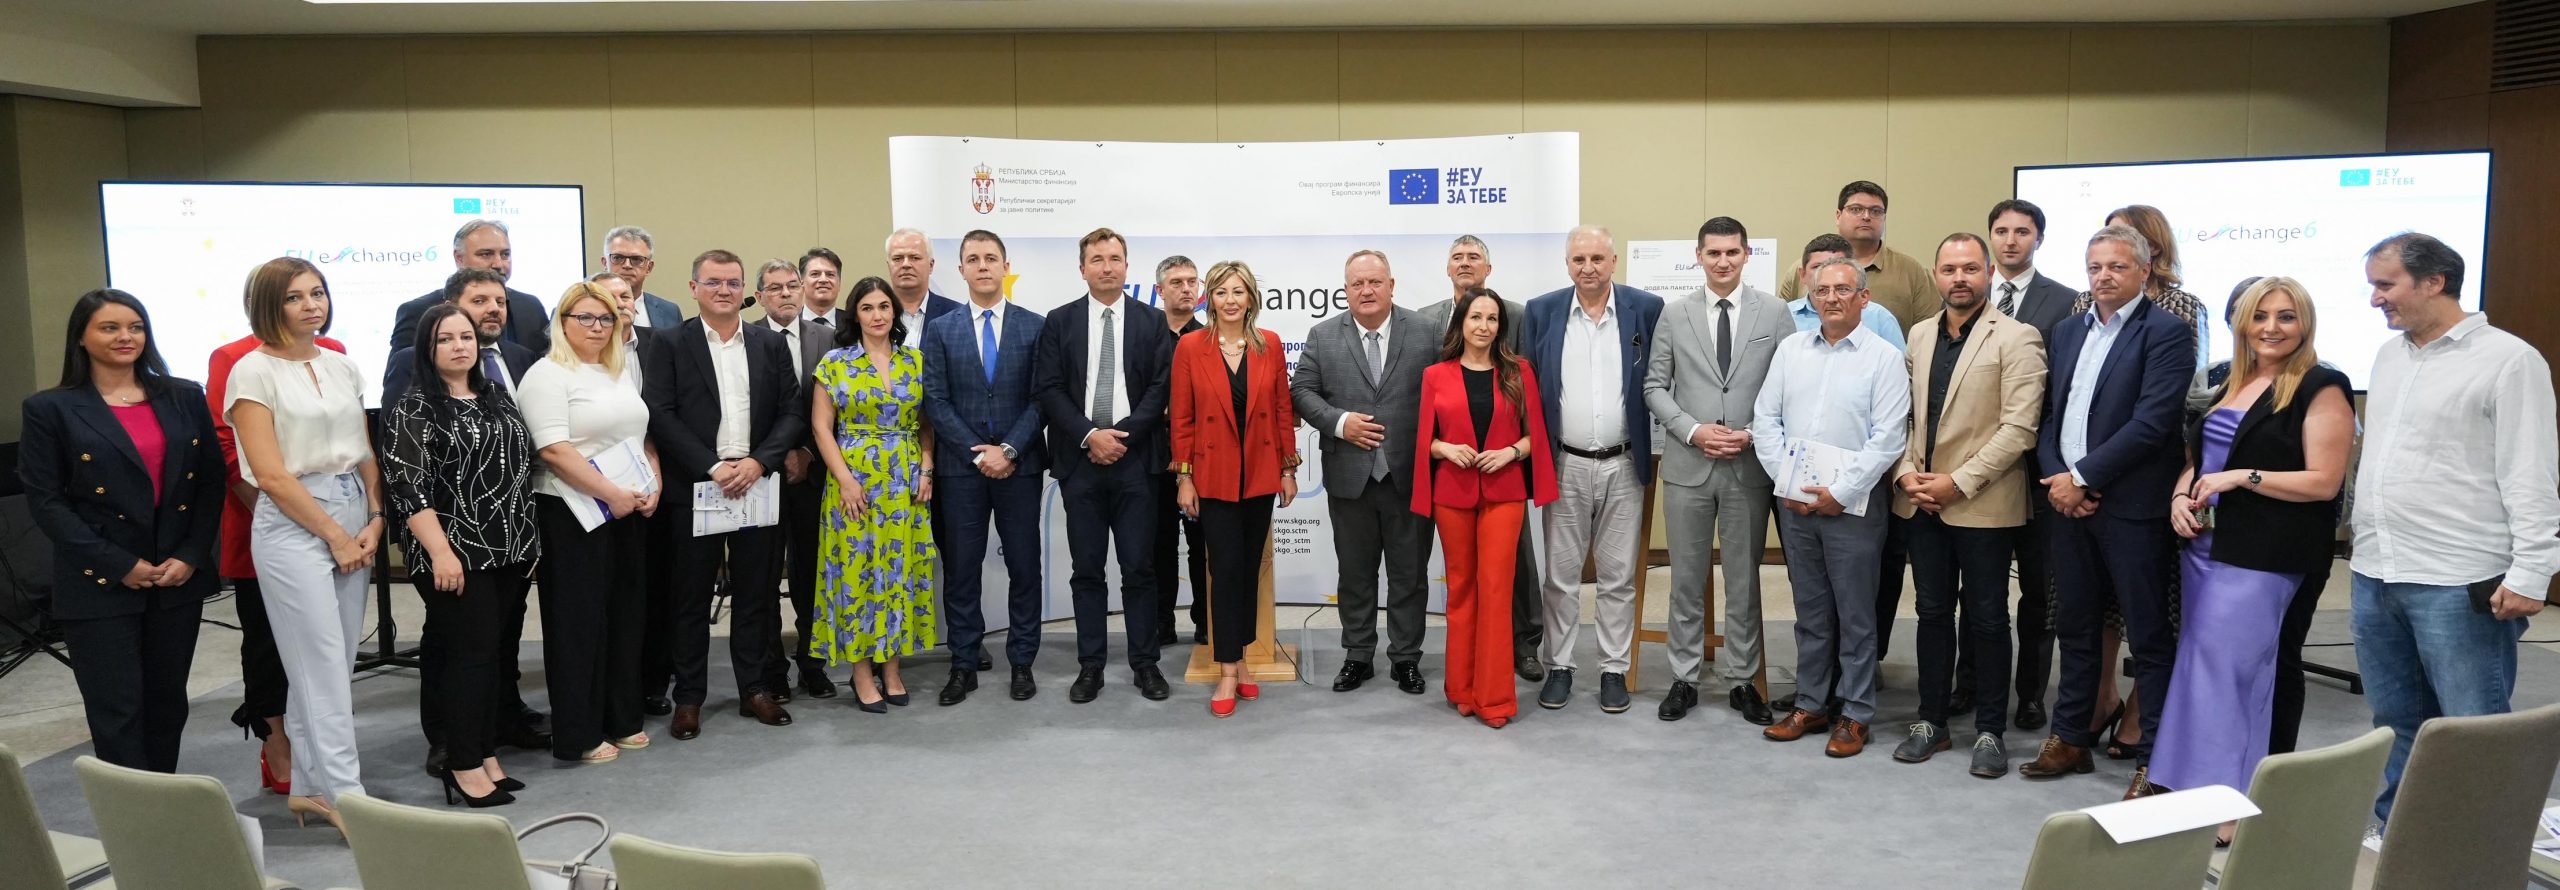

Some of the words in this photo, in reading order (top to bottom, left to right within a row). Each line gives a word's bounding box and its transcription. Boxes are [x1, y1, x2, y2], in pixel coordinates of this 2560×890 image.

[1446, 167, 1483, 186] #ЕУ
[1446, 188, 1466, 204] ЗА
[1469, 187, 1507, 204] ТЕБЕ
[1274, 527, 1308, 535] skgo.sctm
[1274, 537, 1311, 545] skgo_sctm
